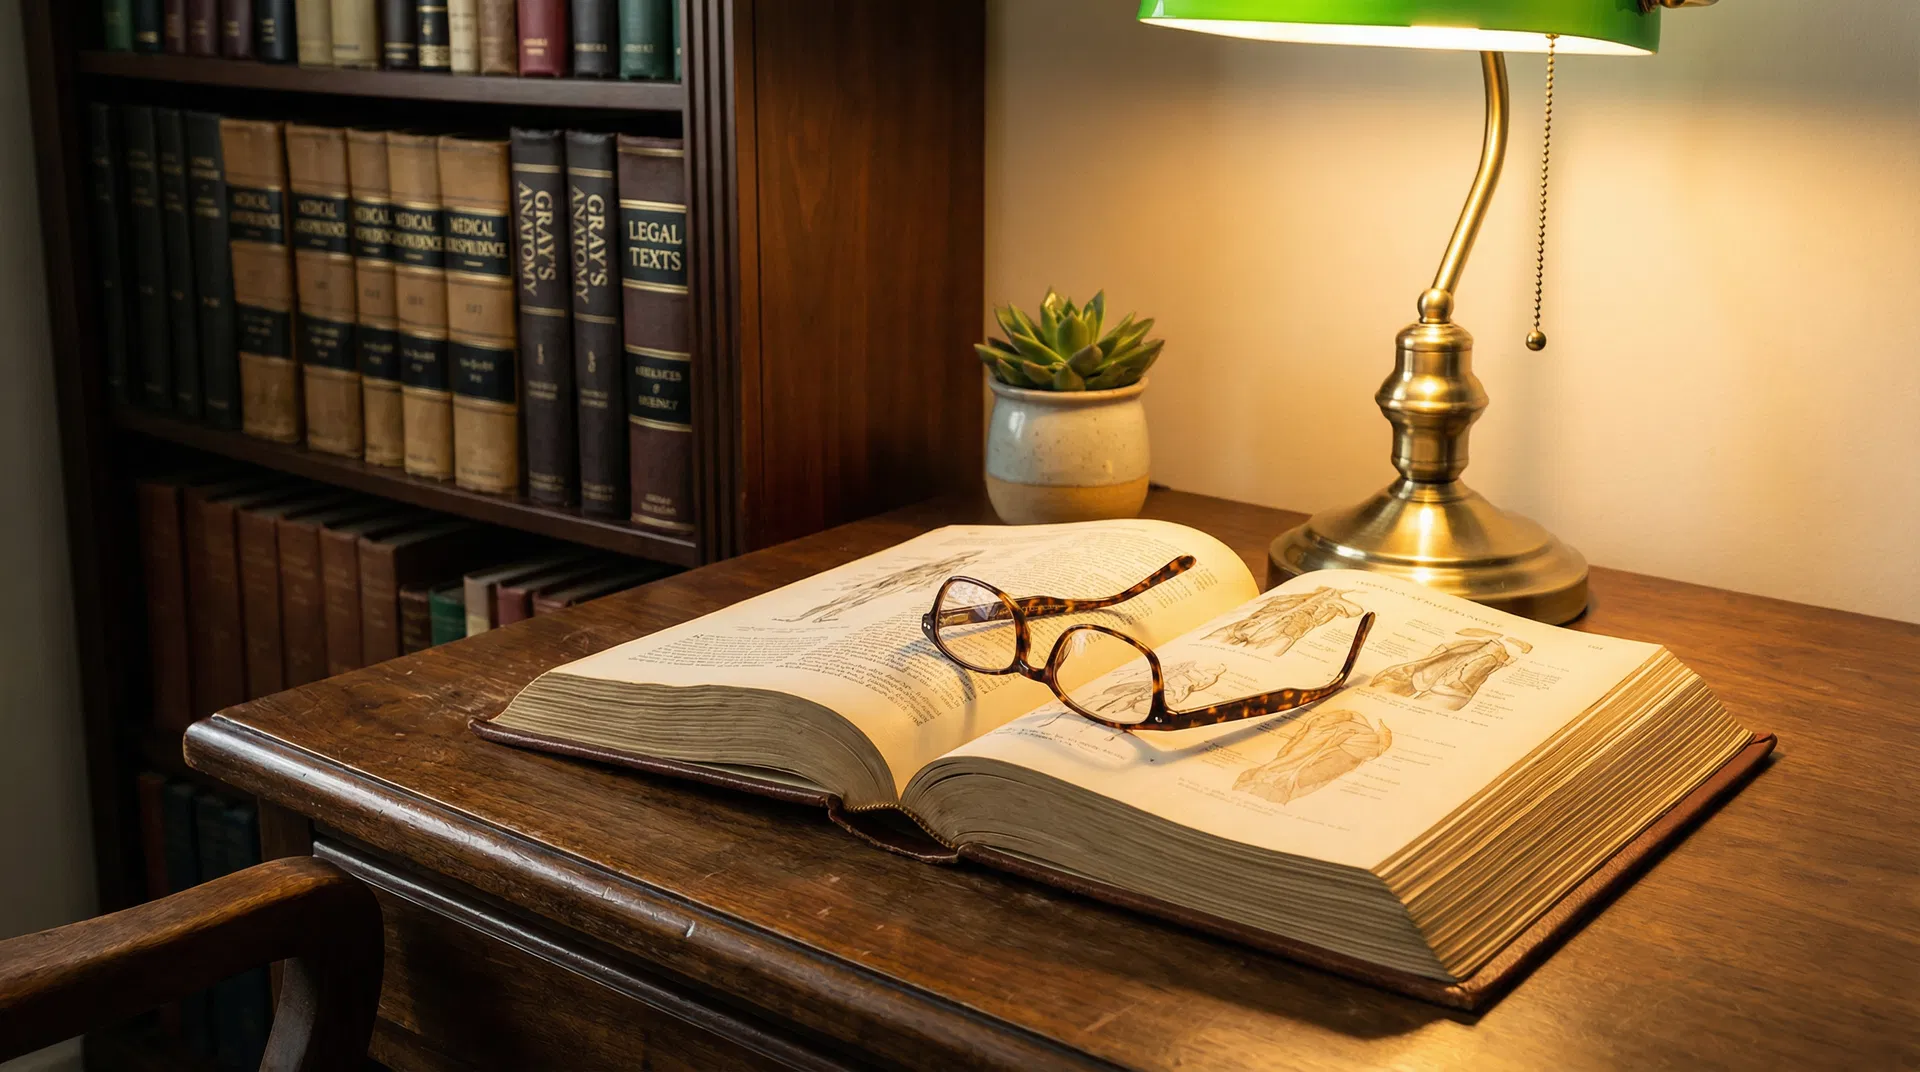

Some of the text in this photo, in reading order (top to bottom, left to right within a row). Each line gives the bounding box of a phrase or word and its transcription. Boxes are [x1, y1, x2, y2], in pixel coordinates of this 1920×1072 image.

[449, 216, 496, 237] MEDICAL
[518, 180, 537, 297] ANATOMY
[534, 190, 556, 281] GRAY'S
[572, 185, 589, 304] ANATOMY
[586, 194, 608, 287] GRAY'S
[628, 220, 683, 245] LEGAL
[628, 246, 682, 271] TEXTS
